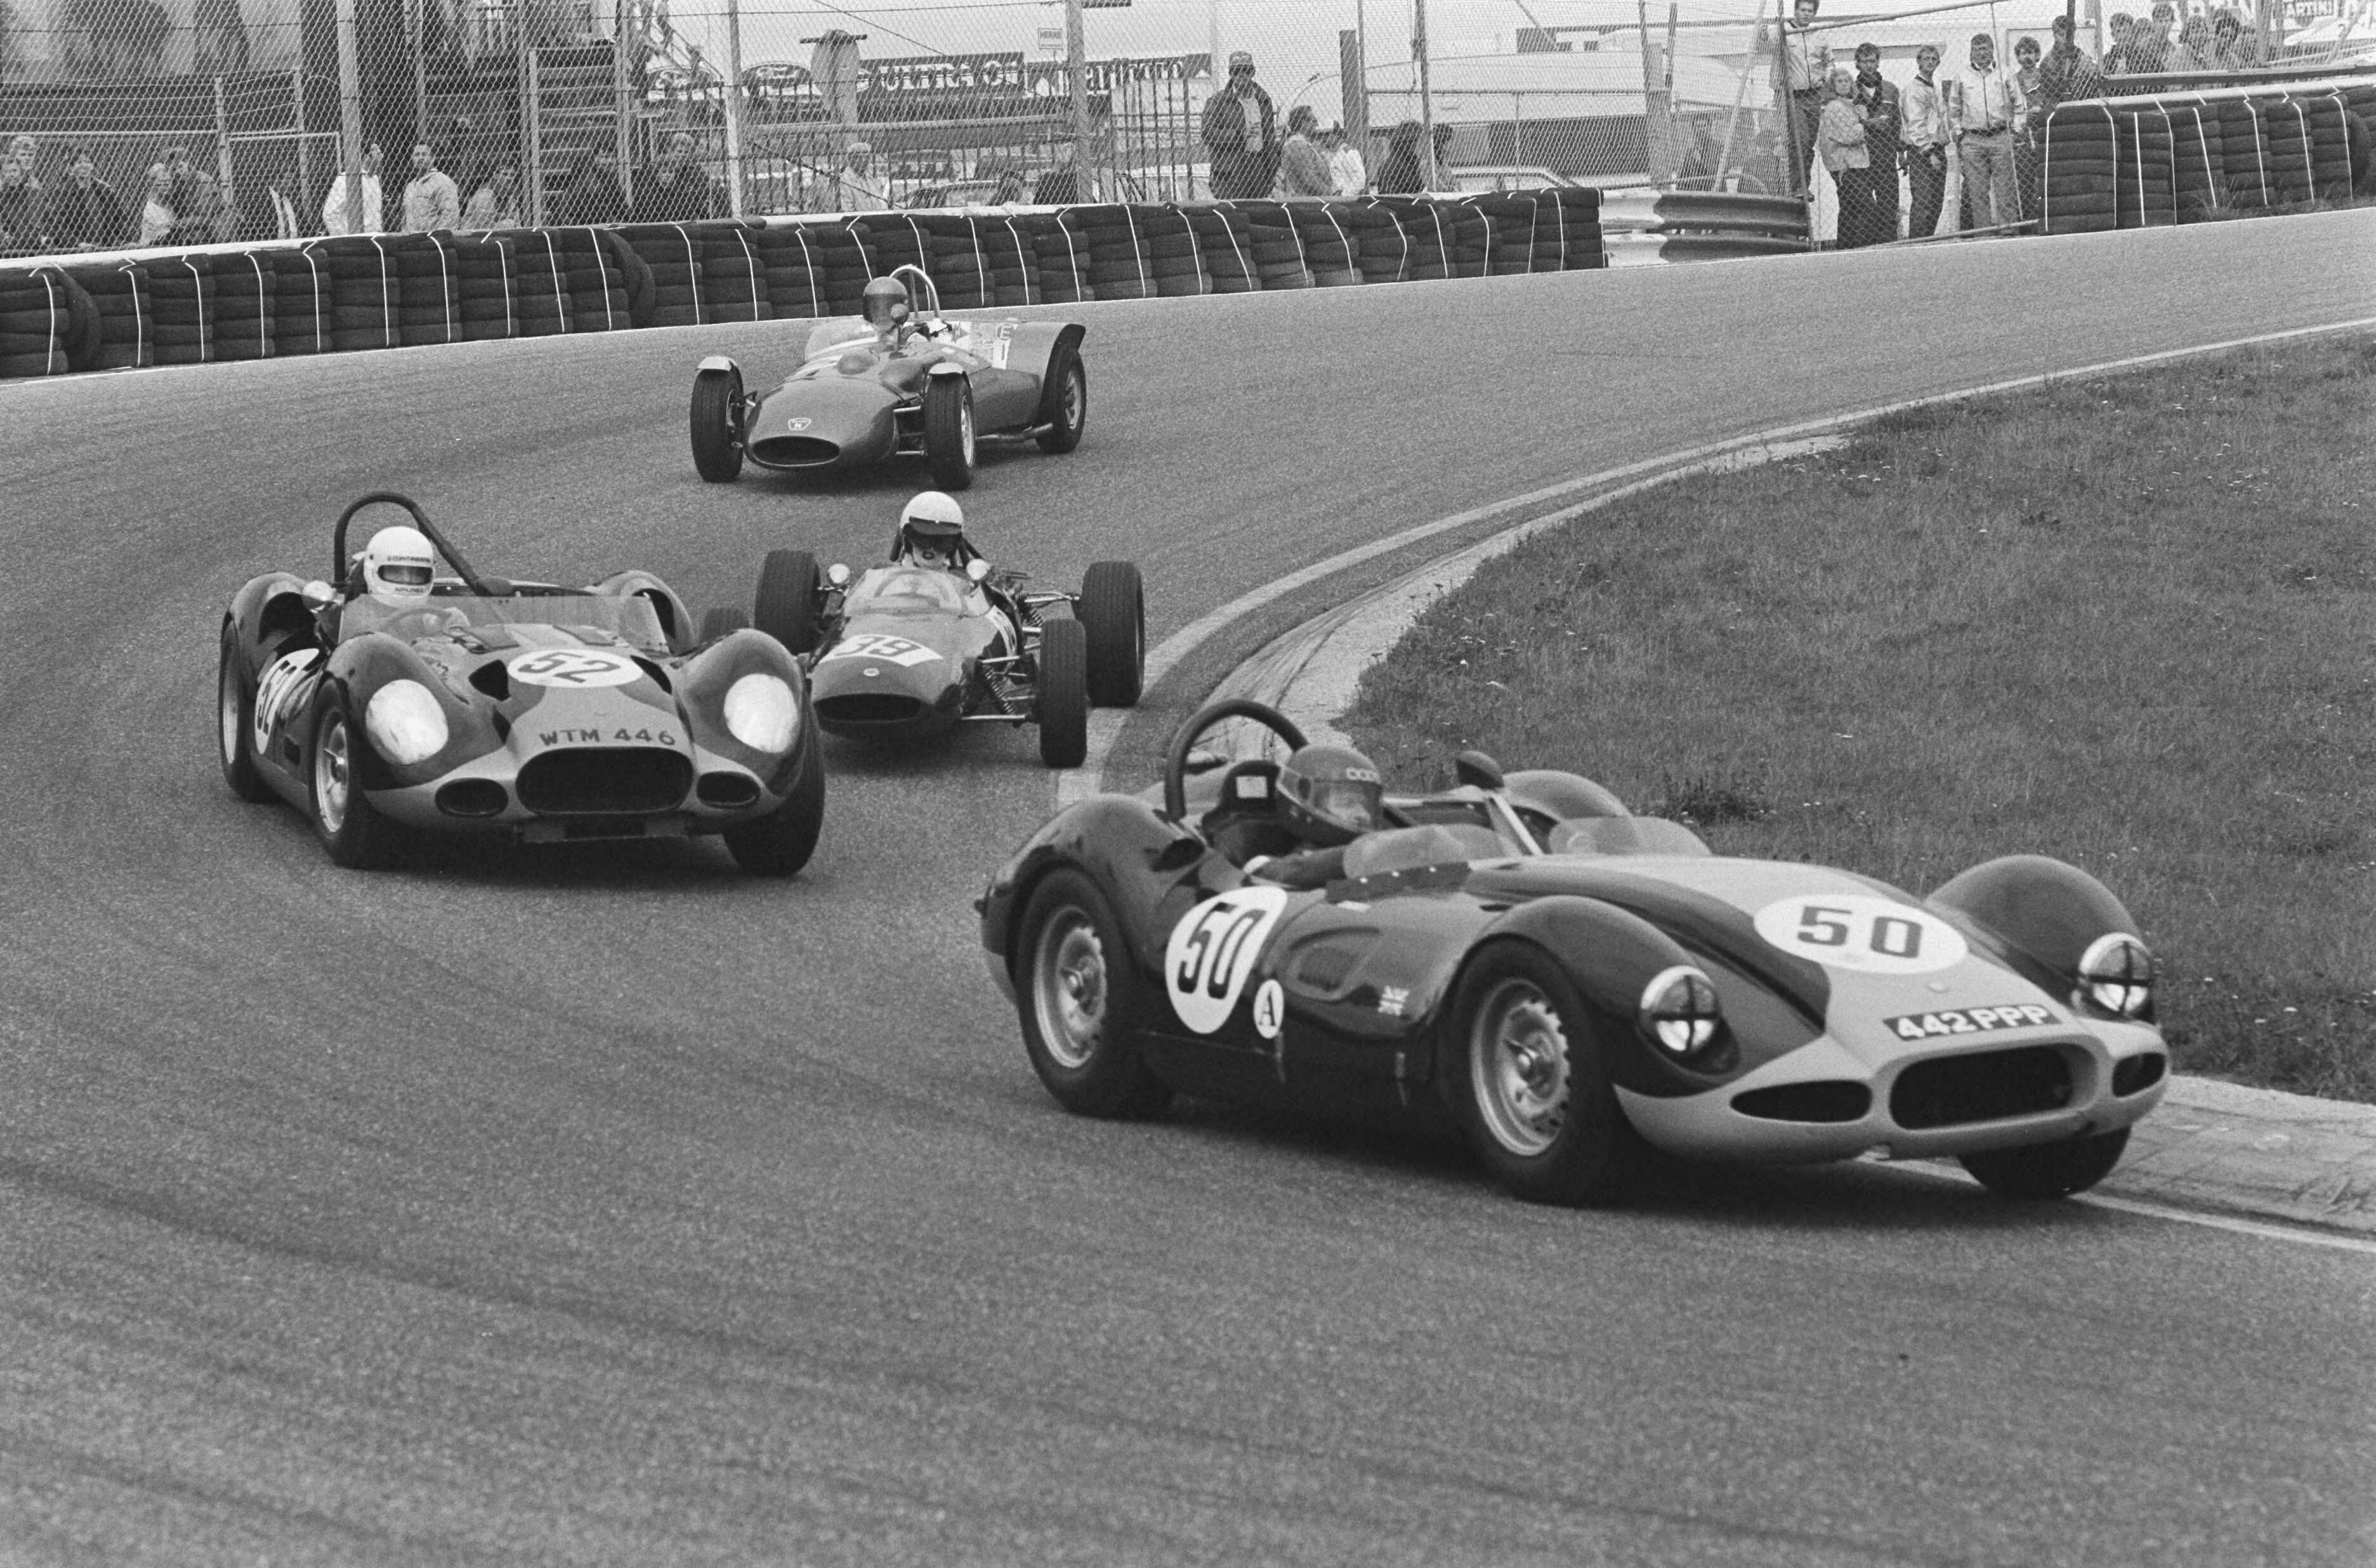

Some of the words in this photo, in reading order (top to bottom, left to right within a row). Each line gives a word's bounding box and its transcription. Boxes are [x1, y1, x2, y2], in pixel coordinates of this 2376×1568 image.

[2278, 2, 2332, 17] ARTINI
[834, 636, 922, 657] 39
[518, 651, 622, 683] 52
[256, 660, 298, 736] 52
[539, 729, 600, 746] WTM
[614, 728, 676, 746] 446
[1797, 905, 1923, 958] 50
[1177, 901, 1268, 1000] 50
[1257, 988, 1277, 1027] A
